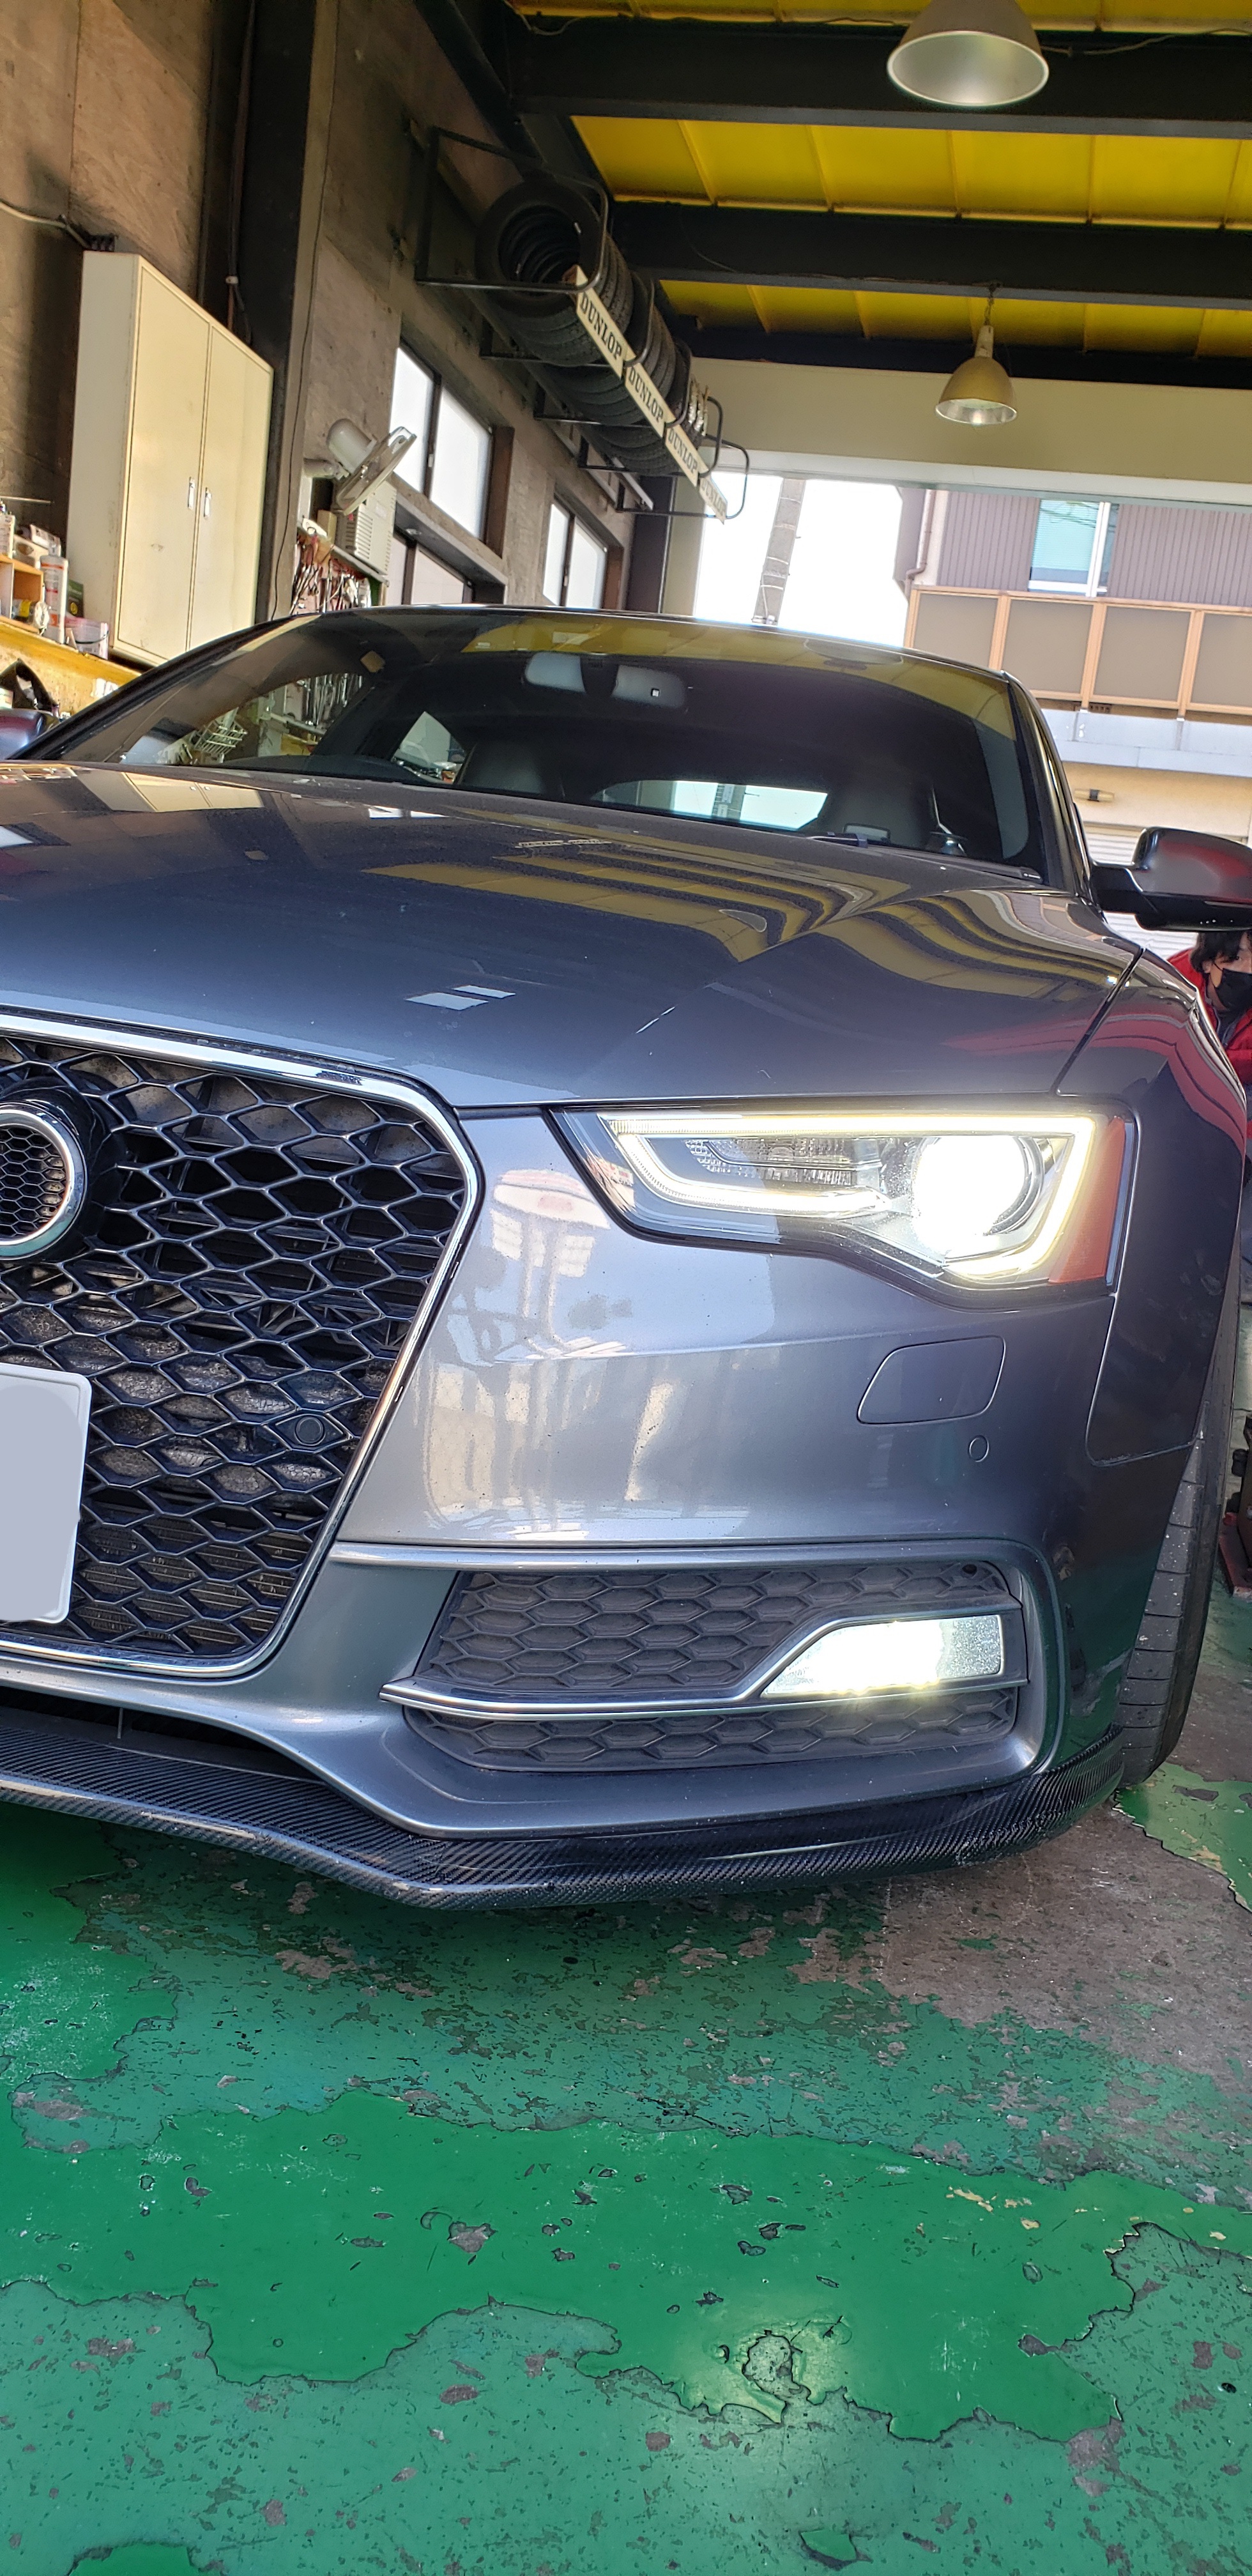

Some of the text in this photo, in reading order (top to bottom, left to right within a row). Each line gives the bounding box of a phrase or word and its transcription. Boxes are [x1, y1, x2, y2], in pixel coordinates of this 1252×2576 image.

[581, 292, 622, 359] DUNLOP
[629, 366, 663, 422] DUNLOP
[668, 428, 698, 473] DUNLOP
